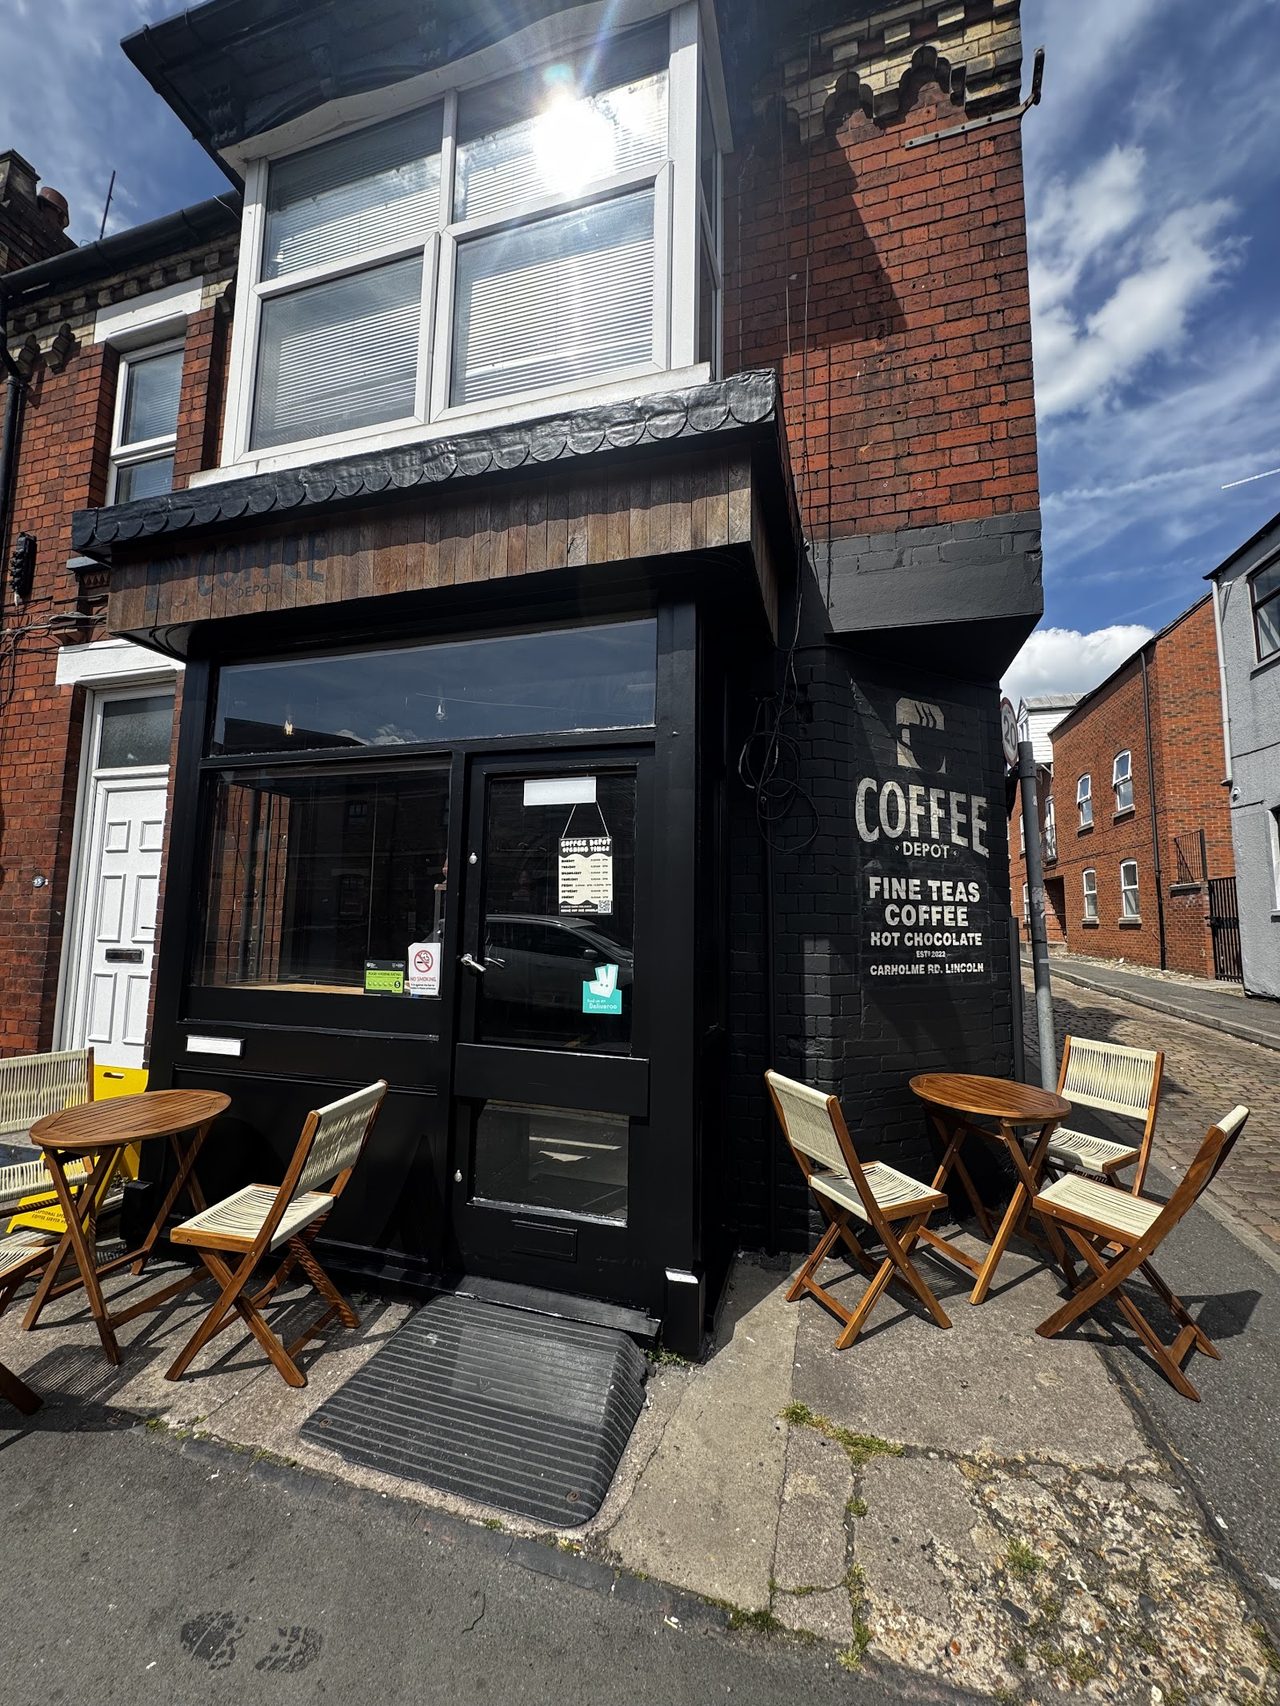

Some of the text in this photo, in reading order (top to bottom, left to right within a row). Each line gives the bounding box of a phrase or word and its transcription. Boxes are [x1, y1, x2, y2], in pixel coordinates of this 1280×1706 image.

[197, 532, 327, 596] COFFEE
[235, 583, 279, 598] DEPOT
[1004, 714, 1016, 751] 20
[855, 777, 990, 858] COFFEE
[903, 841, 949, 859] DEPOT
[869, 876, 980, 903] FINE TEAS
[885, 904, 969, 927] COFFEE
[870, 931, 982, 947] HOT CHOCOLATE
[870, 964, 925, 976] CARHOLME
[945, 962, 984, 974] LINCOLN
